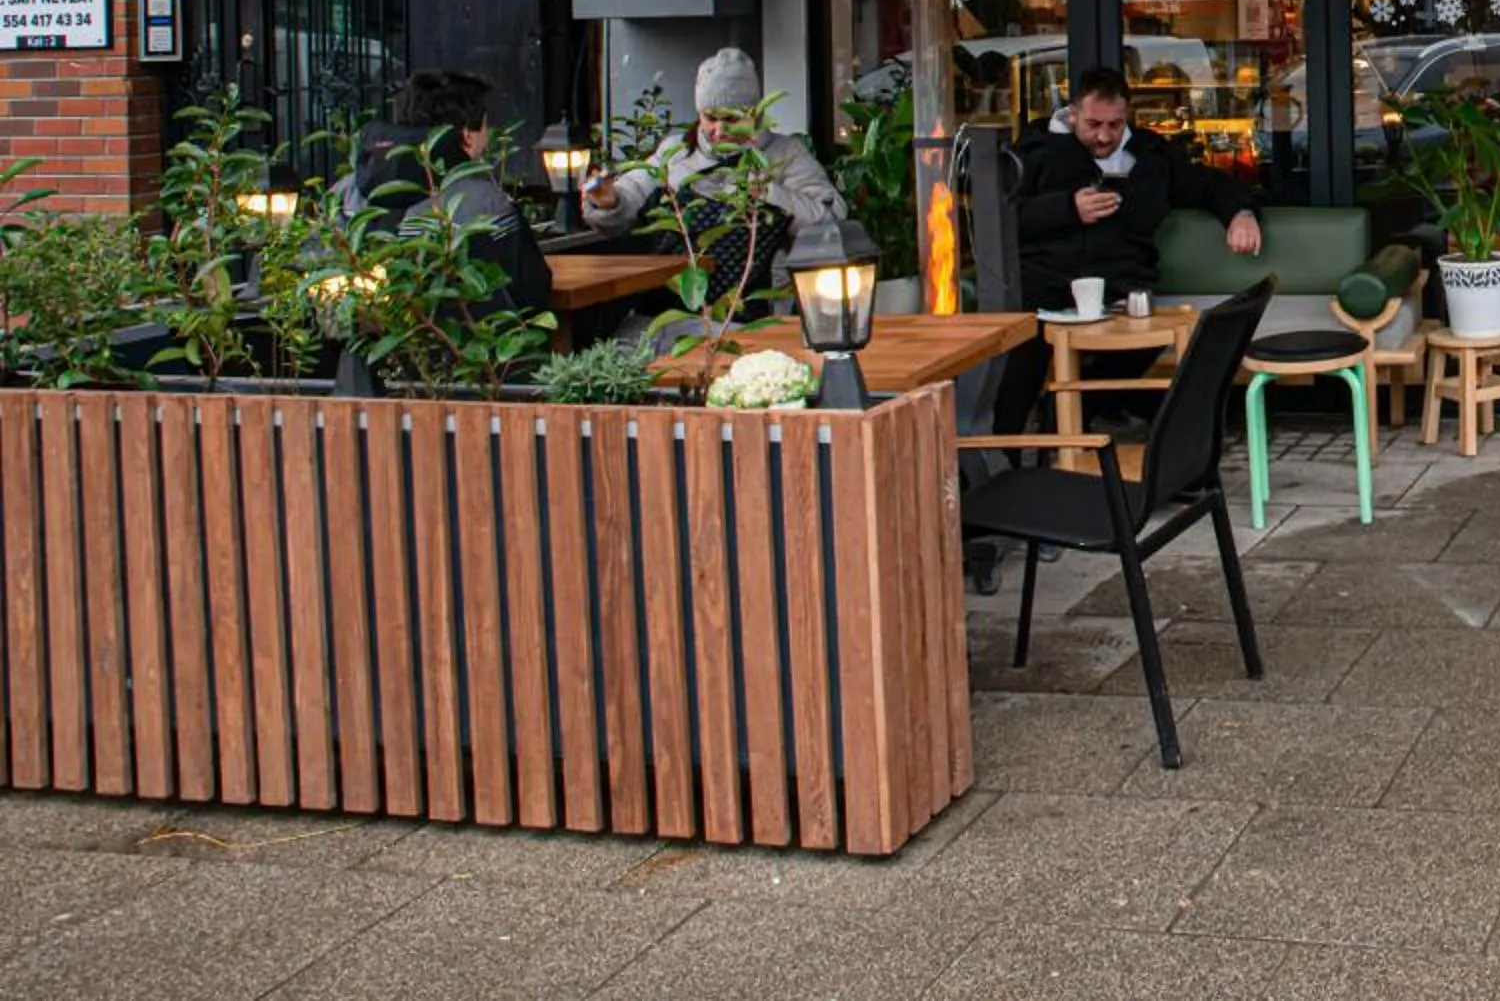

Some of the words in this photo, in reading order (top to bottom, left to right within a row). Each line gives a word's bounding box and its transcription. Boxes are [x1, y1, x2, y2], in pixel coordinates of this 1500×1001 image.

[3, 14, 27, 28] 554
[31, 13, 53, 28] 417
[56, 12, 73, 27] 43
[75, 12, 92, 26] 34
